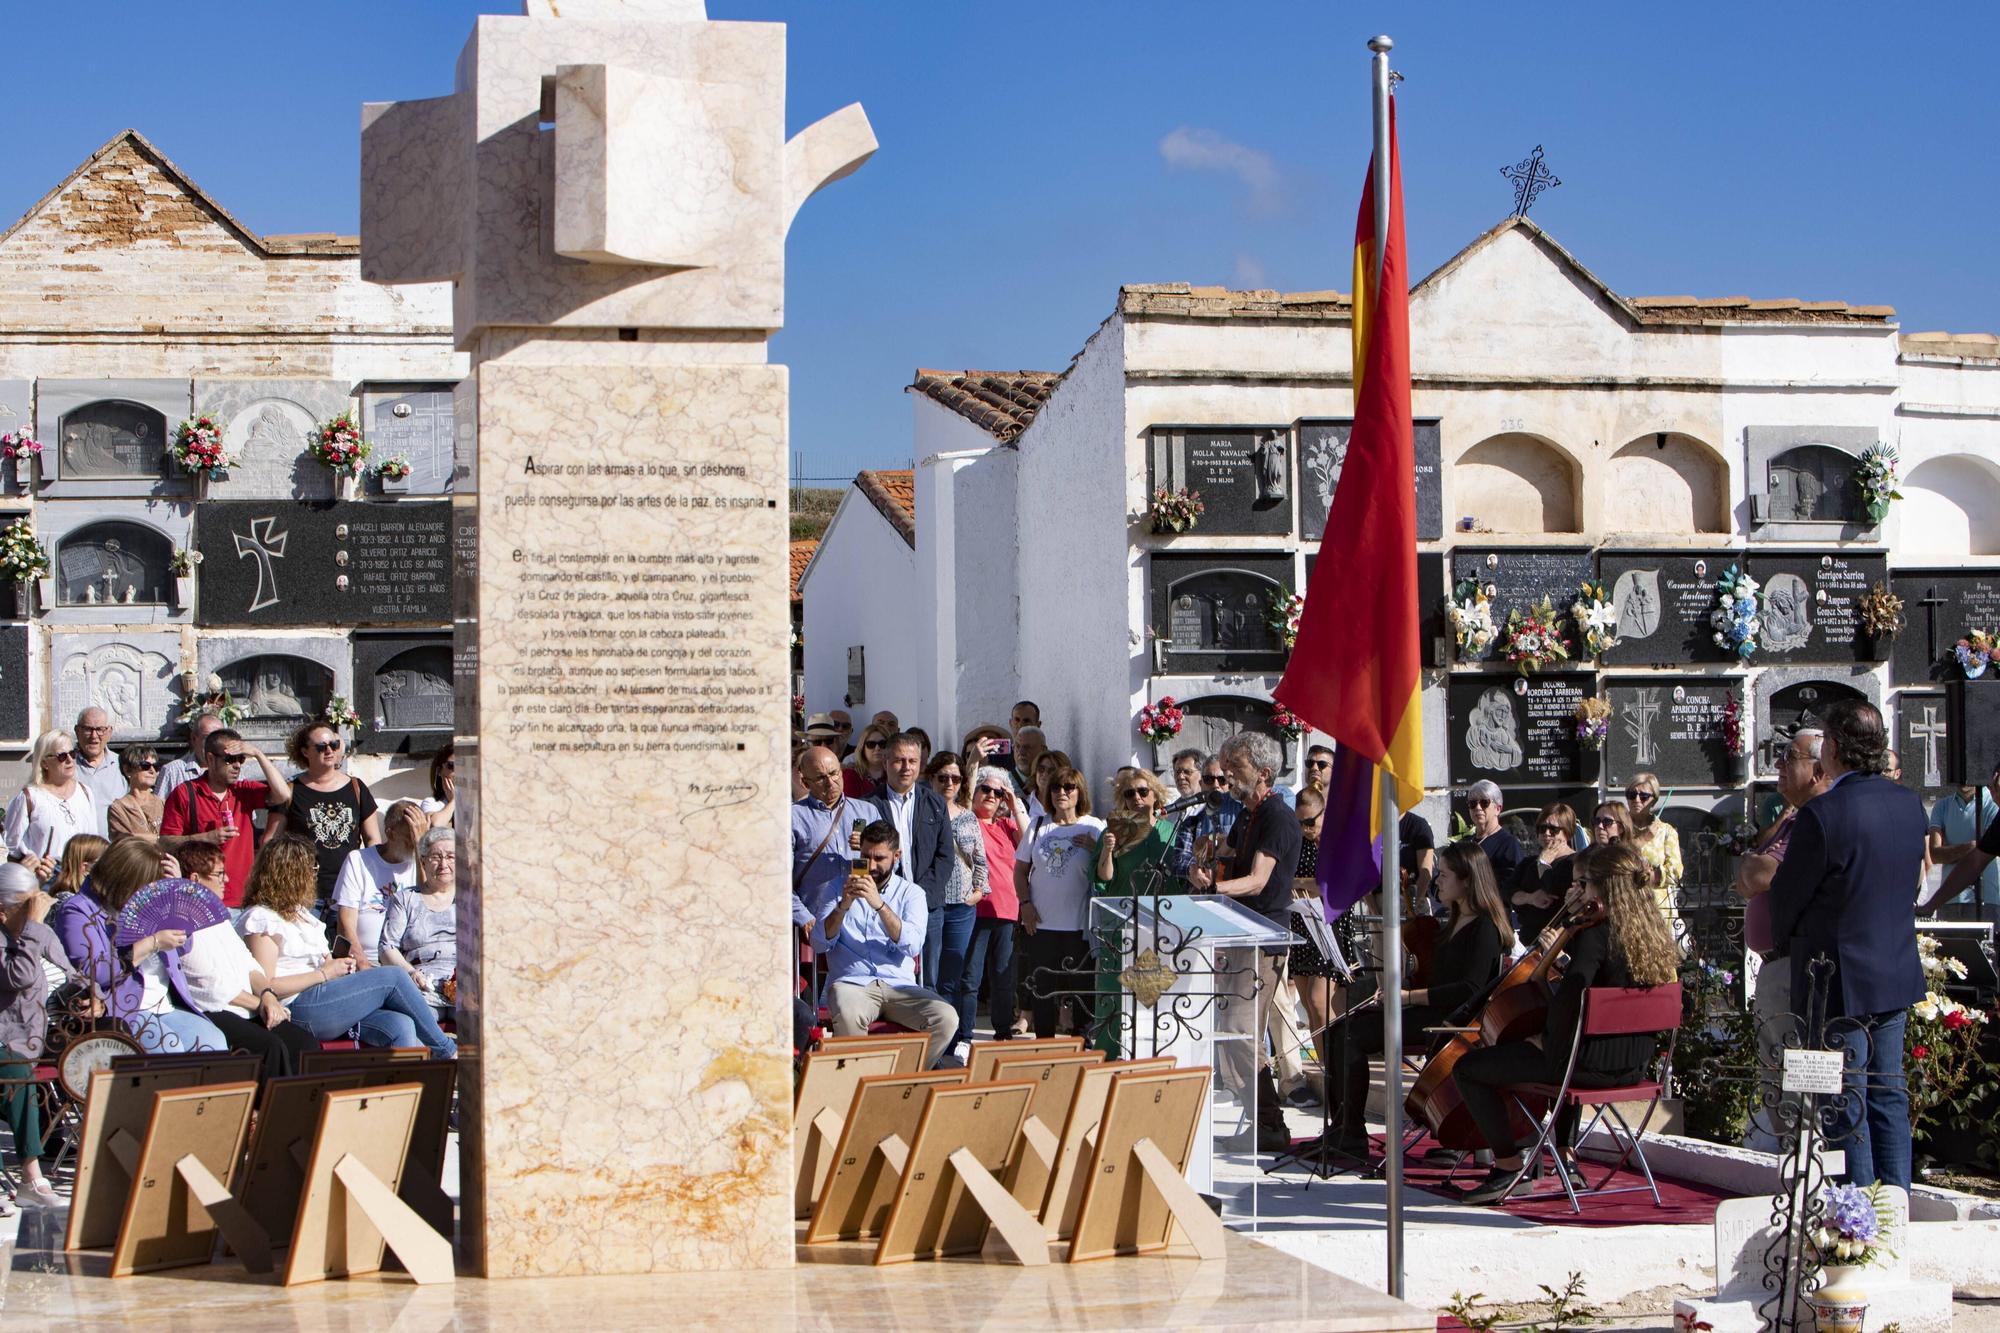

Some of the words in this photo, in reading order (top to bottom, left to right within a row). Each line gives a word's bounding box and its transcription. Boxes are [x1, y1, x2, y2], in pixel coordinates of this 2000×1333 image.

[524, 456, 564, 476] Aspirar
[566, 465, 584, 475] con
[587, 463, 601, 475] las
[604, 465, 634, 475] armas
[638, 465, 644, 475] a
[647, 463, 656, 476] lo
[684, 464, 697, 476] sin
[505, 494, 536, 508] puede
[539, 495, 598, 510] conseguirse
[601, 495, 616, 508] por
[619, 493, 634, 507] las
[636, 495, 662, 507] artes
[664, 494, 676, 507] de
[680, 494, 688, 507] la
[715, 496, 726, 507] es
[560, 552, 610, 564] contemplar
[627, 552, 636, 562] la
[638, 553, 672, 564] cumbre
[698, 553, 714, 563] alta
[726, 554, 760, 566] agreste
[632, 572, 639, 582] el
[710, 572, 718, 582] el
[528, 590, 536, 600] la
[538, 590, 560, 600] Cruz
[564, 590, 574, 600] de
[616, 590, 648, 602] aquella
[652, 591, 670, 600] otra
[518, 609, 560, 619] desolada
[608, 611, 624, 622] que
[628, 609, 640, 619] los
[672, 609, 694, 619] visto
[696, 609, 714, 619] salir
[550, 628, 565, 638] los
[620, 630, 636, 638] con
[638, 628, 647, 638] la
[650, 629, 683, 638] cabeza
[519, 648, 528, 657] el
[530, 648, 560, 658] pecho
[562, 649, 572, 657] se
[576, 648, 589, 657] les
[592, 647, 634, 657] hinchaba
[636, 648, 648, 657] de
[650, 648, 688, 660] congoja
[698, 648, 712, 657] del
[568, 668, 603, 677] aunque
[606, 668, 618, 676] no
[621, 666, 662, 677] supiesen
[664, 666, 710, 676] formularla
[713, 666, 726, 676] los
[498, 684, 505, 694] la
[667, 684, 678, 694] de
[682, 684, 698, 694] mis
[700, 684, 723, 694] años
[726, 684, 756, 694] vuelvo
[758, 686, 764, 694] a
[512, 704, 524, 714] en
[527, 704, 546, 714] este
[550, 704, 572, 714] claro
[595, 704, 608, 714] De
[612, 704, 639, 714] tantas
[642, 704, 695, 715] esperanzas
[510, 724, 524, 734] por
[528, 722, 540, 732] fin
[542, 722, 554, 732] he
[557, 722, 604, 732] alcanzado
[630, 722, 638, 732] la
[641, 724, 658, 735] que
[661, 724, 689, 732] nunca
[532, 742, 556, 751] tener
[560, 742, 570, 751] mi
[574, 740, 616, 753] sepultura
[618, 742, 630, 751] en
[633, 742, 644, 751] su
[646, 740, 670, 751] tierra
